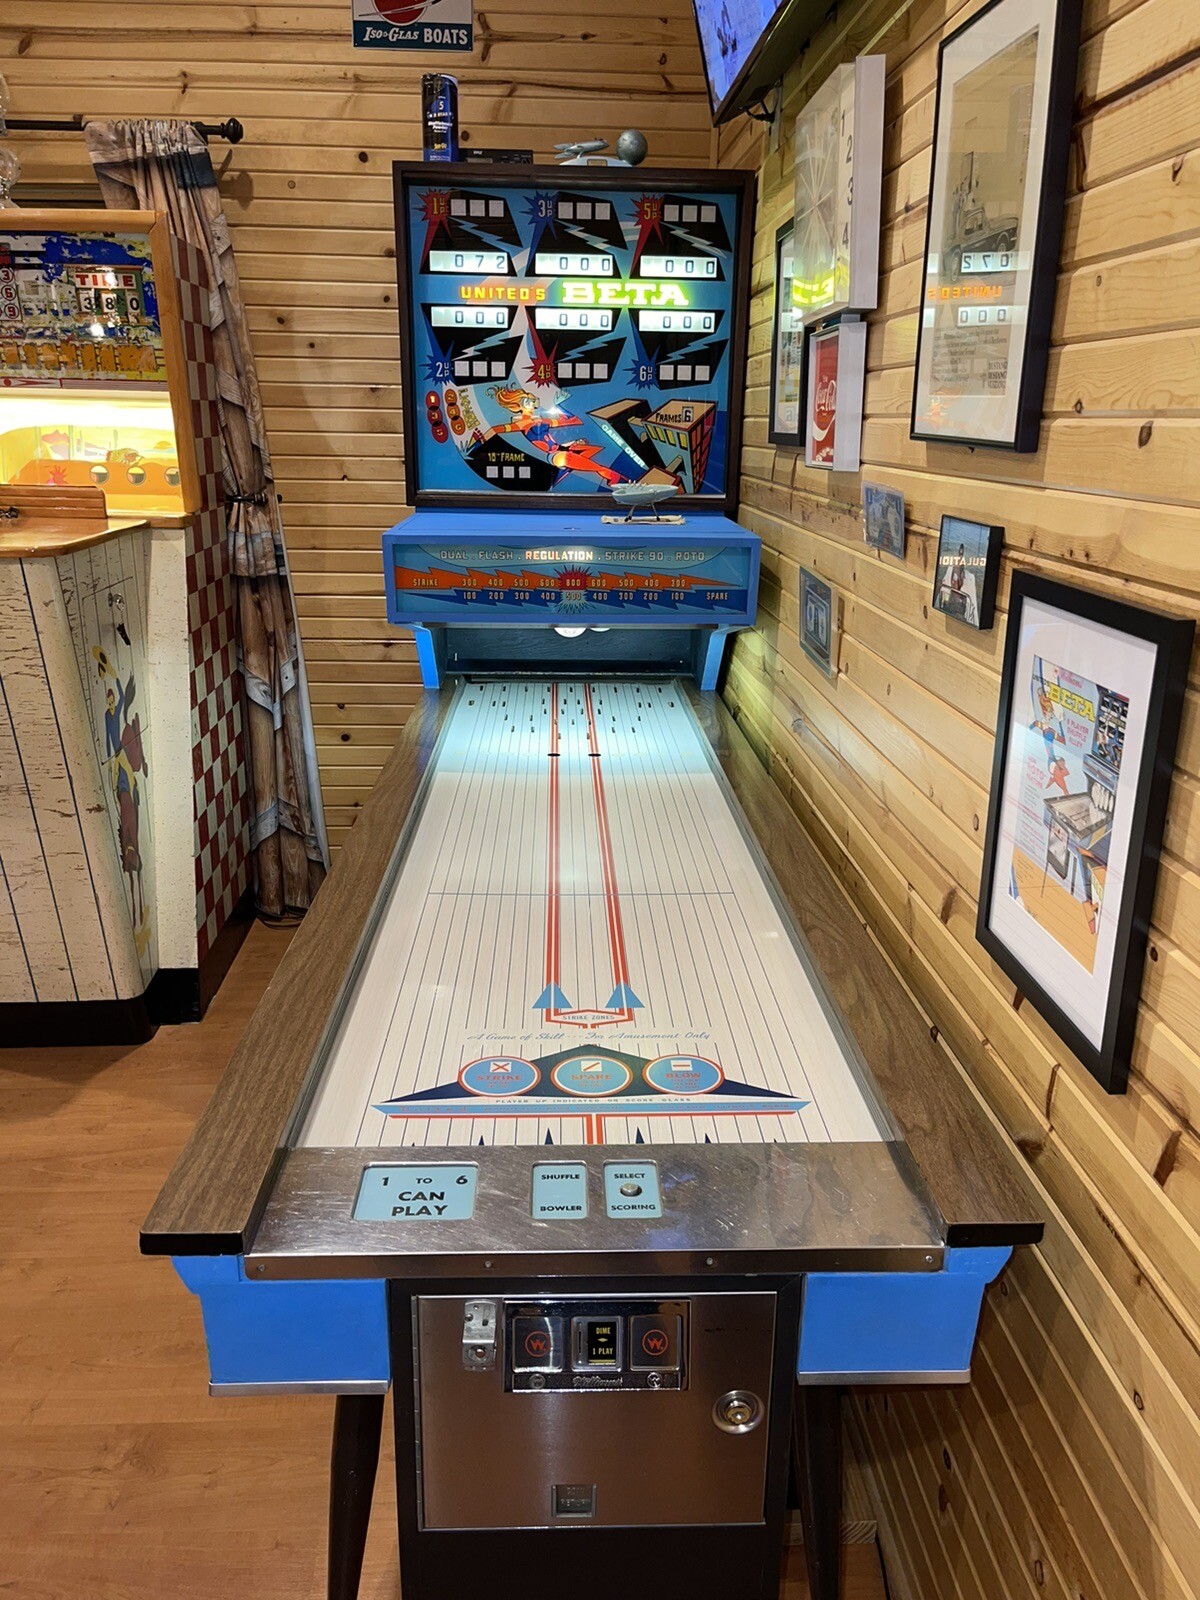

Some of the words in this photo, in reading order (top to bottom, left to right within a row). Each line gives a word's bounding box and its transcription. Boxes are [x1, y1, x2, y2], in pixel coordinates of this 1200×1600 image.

[424, 28, 468, 45] BOATS
[845, 134, 852, 164] 2
[847, 176, 853, 206] 3
[842, 222, 849, 250] 4
[2, 270, 10, 280] 3
[5, 288, 12, 297] 6
[460, 286, 546, 301] UNITED'S
[562, 282, 690, 306] BETA
[8, 306, 16, 316] 9
[430, 395, 436, 403] 1
[432, 412, 438, 420] 3
[655, 412, 682, 423] FRAMES
[684, 409, 692, 422] 6
[601, 423, 625, 446] GAME
[624, 444, 646, 468] OVER
[500, 453, 525, 462] FRAME
[440, 551, 469, 560] DUAL
[478, 551, 513, 560] FLASH
[525, 551, 593, 561] REGULATION
[604, 552, 644, 561] STRIKE
[649, 552, 664, 561] 90
[675, 552, 705, 561] ROTO
[413, 578, 439, 586] STRIKE
[462, 578, 477, 587] 300
[488, 578, 503, 587] 400
[514, 578, 529, 587] 500
[539, 578, 555, 587] 600
[565, 578, 581, 587] 800
[591, 578, 606, 587] 600
[619, 578, 634, 587] 500
[644, 578, 659, 587] 400
[671, 578, 686, 587] 300
[463, 592, 477, 600] 100
[488, 592, 504, 600] 200
[514, 592, 530, 600] 300
[540, 592, 555, 600] 400
[565, 592, 581, 600] 500
[592, 592, 608, 600] 400
[618, 592, 634, 600] 300
[643, 592, 658, 600] 200
[671, 592, 684, 600] 100
[706, 592, 728, 600] SPARE
[1047, 681, 1095, 723] BETA
[1071, 720, 1089, 734] PLAYER
[585, 1032, 604, 1040] For
[684, 1032, 710, 1040] Only
[382, 1176, 390, 1186] 1
[456, 1175, 468, 1185] 6
[398, 1191, 445, 1201] CAN
[391, 1205, 448, 1216] PLAY
[595, 1327, 611, 1335] DIME
[598, 1347, 613, 1355] PLAY
